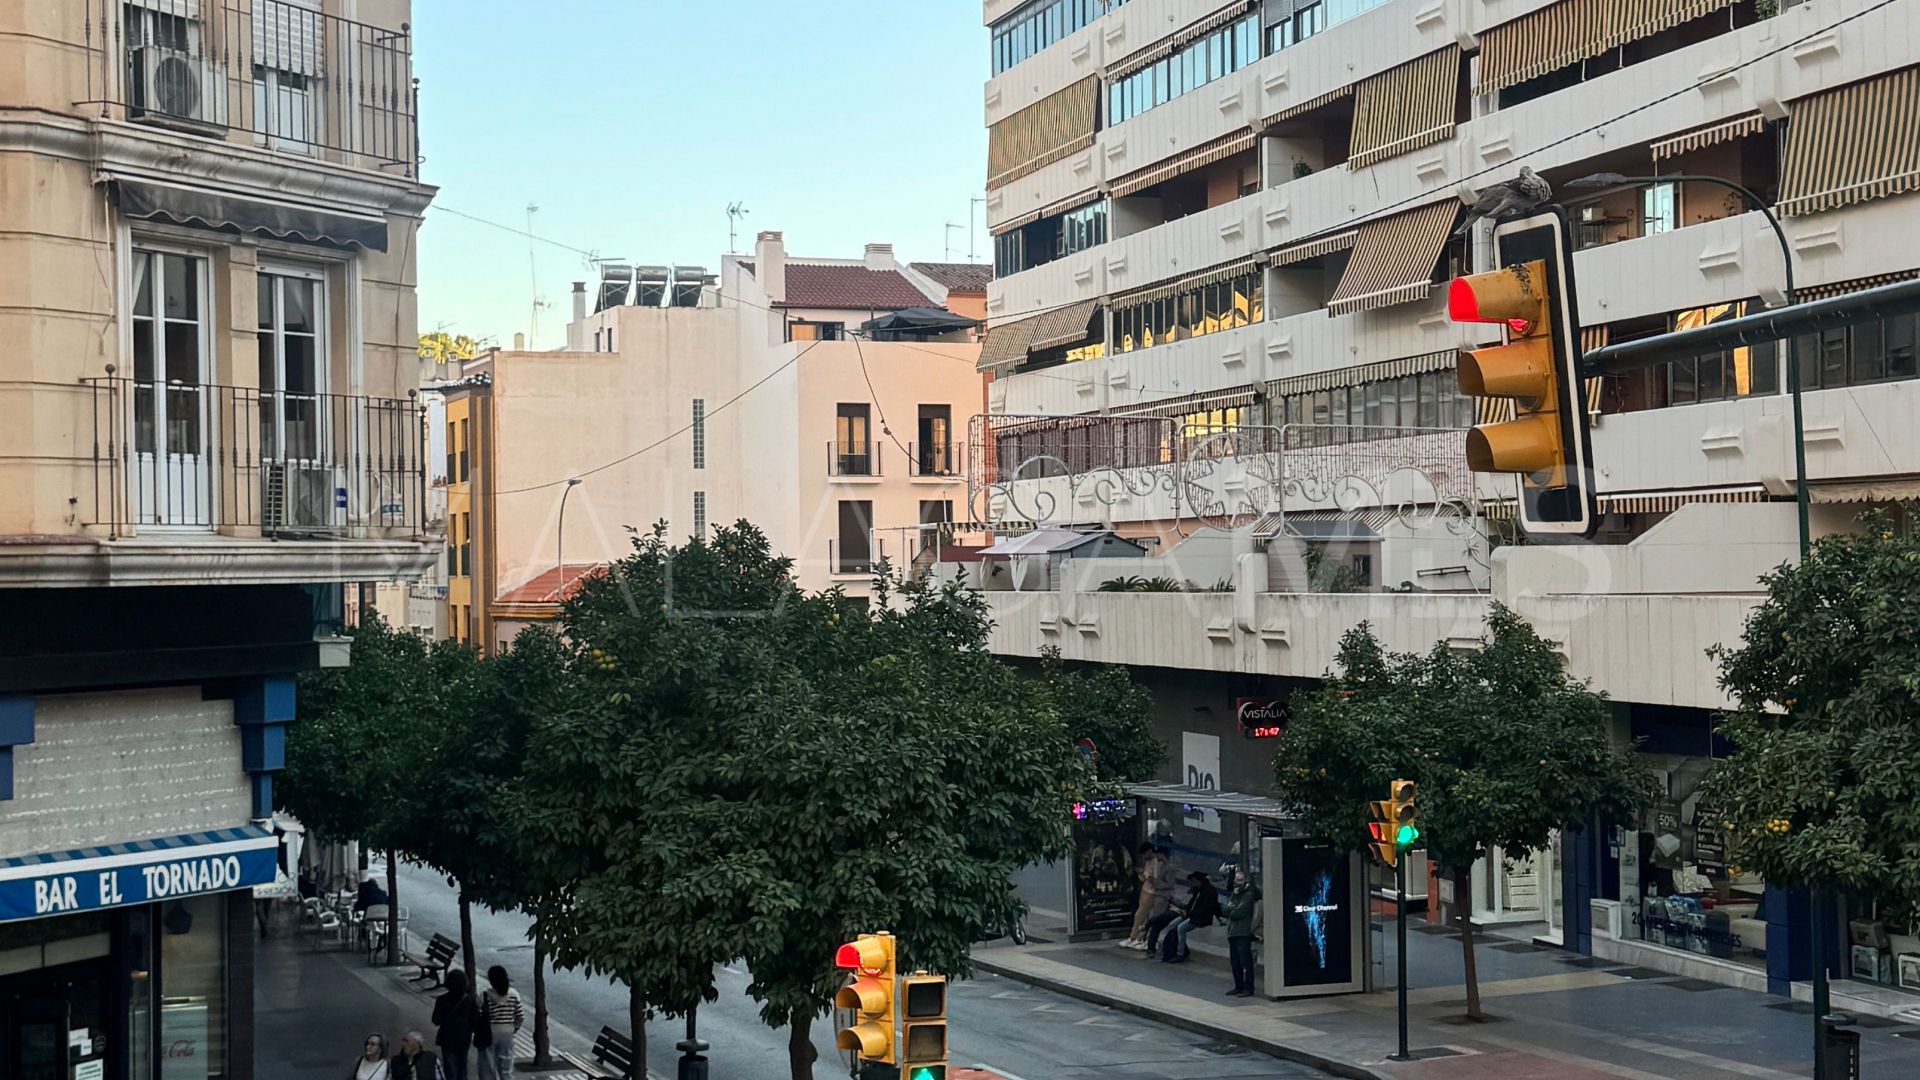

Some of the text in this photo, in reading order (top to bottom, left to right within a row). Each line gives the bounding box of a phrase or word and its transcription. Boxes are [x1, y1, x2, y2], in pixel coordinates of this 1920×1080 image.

[1243, 709, 1287, 719] VISTALIA
[1659, 814, 1678, 828] 50%
[35, 855, 241, 914] BAR EL TORNADO
